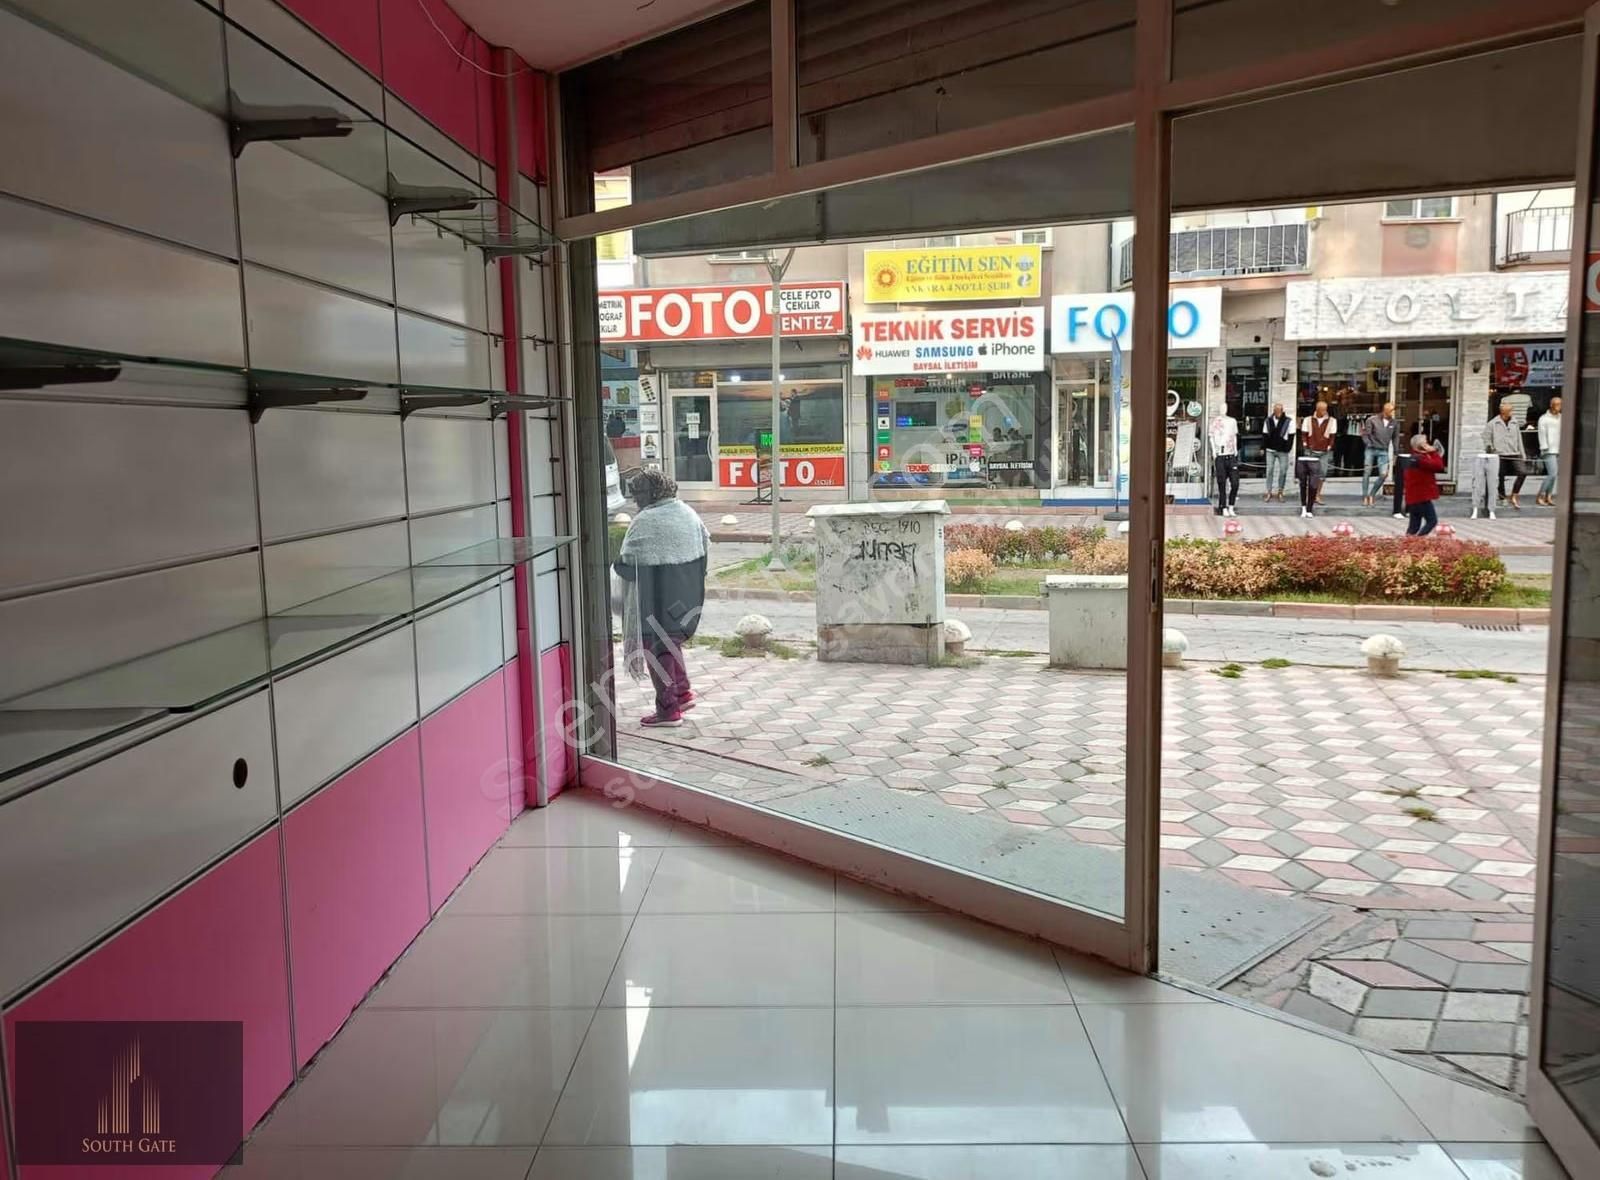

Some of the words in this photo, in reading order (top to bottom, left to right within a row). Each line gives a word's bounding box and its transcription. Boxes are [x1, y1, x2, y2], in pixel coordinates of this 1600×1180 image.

[907, 254, 972, 274] EĞİTİM
[978, 255, 1012, 273] SEN
[780, 290, 802, 301] CELE
[805, 290, 832, 300] FOTO
[631, 290, 761, 337] FOTO
[1068, 301, 1200, 342] FOO
[781, 315, 834, 331] ENTEZ
[860, 313, 944, 342] TEKNİK
[951, 311, 1035, 340] SERVİS
[875, 349, 910, 358] HUAWEI
[915, 345, 974, 358] SAMSUNG
[991, 342, 1036, 356] iPhone
[913, 362, 943, 371] BAYSAL
